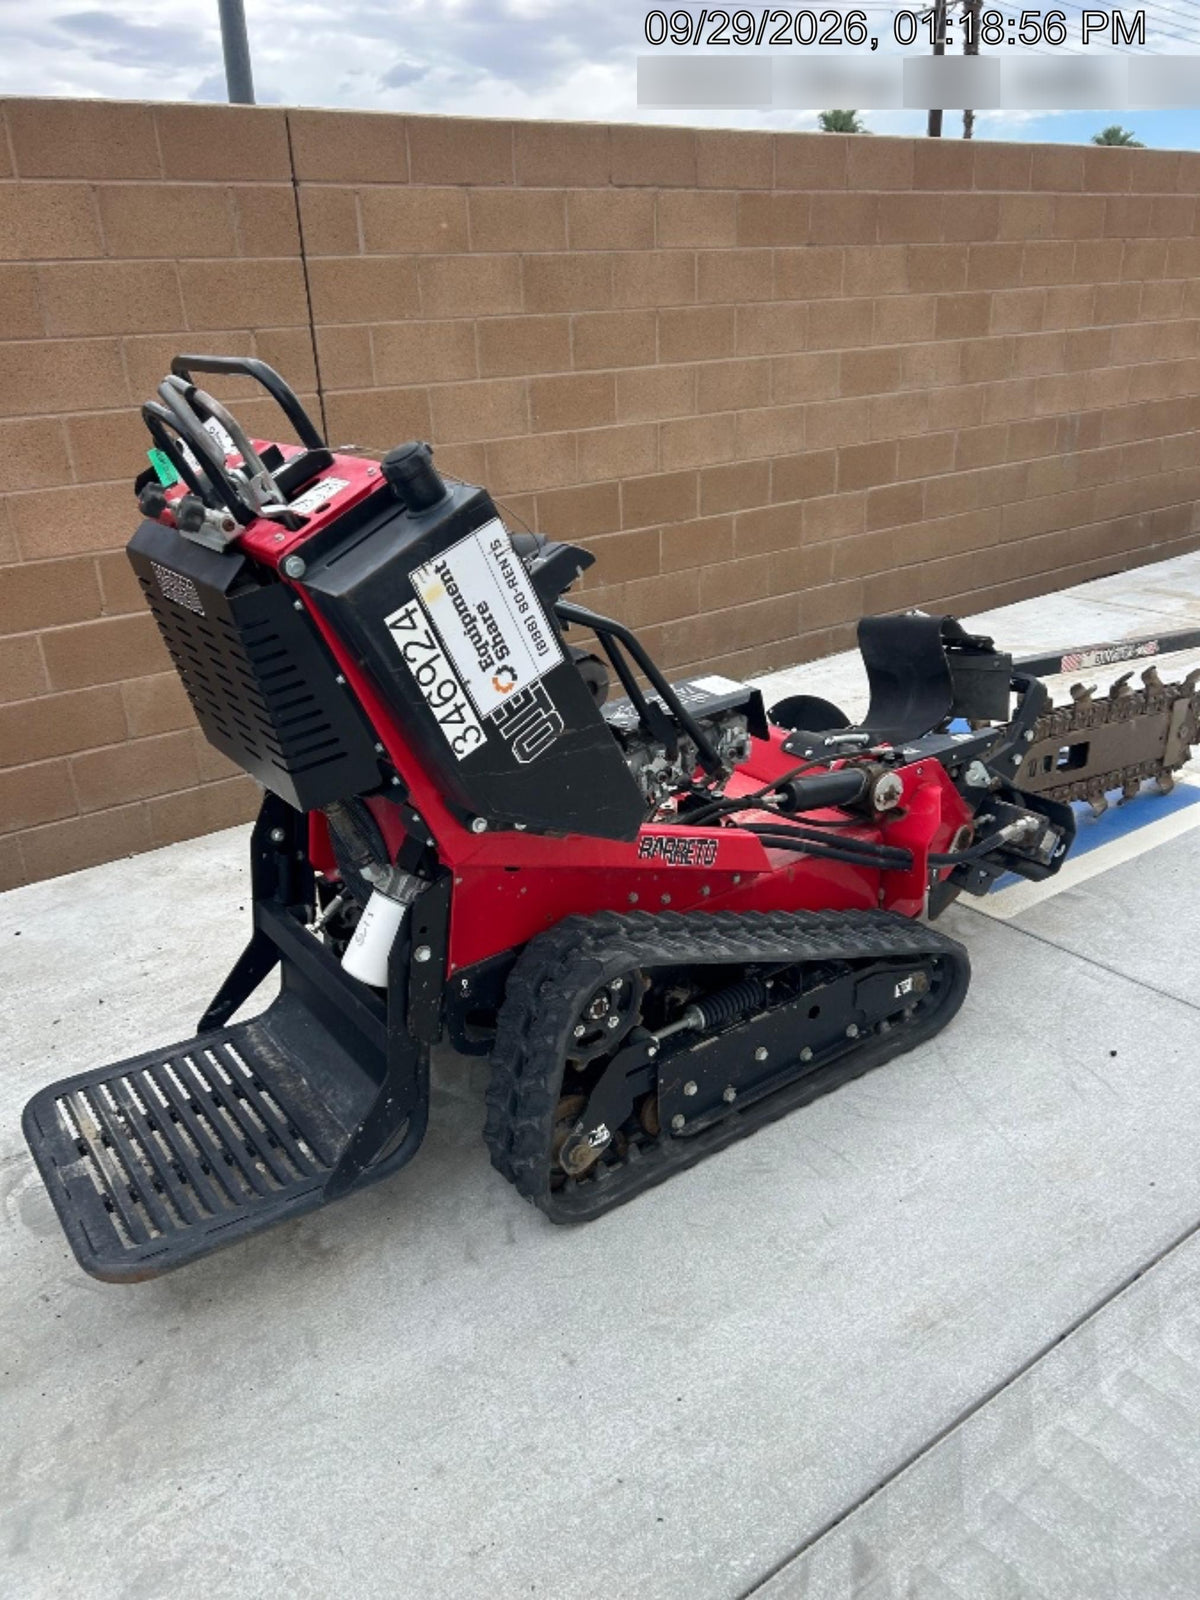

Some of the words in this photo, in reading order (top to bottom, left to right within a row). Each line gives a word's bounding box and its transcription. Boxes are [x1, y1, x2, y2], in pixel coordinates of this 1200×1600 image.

[434, 560, 495, 672] Equipment
[476, 601, 510, 661] Share
[389, 608, 481, 754] 346924
